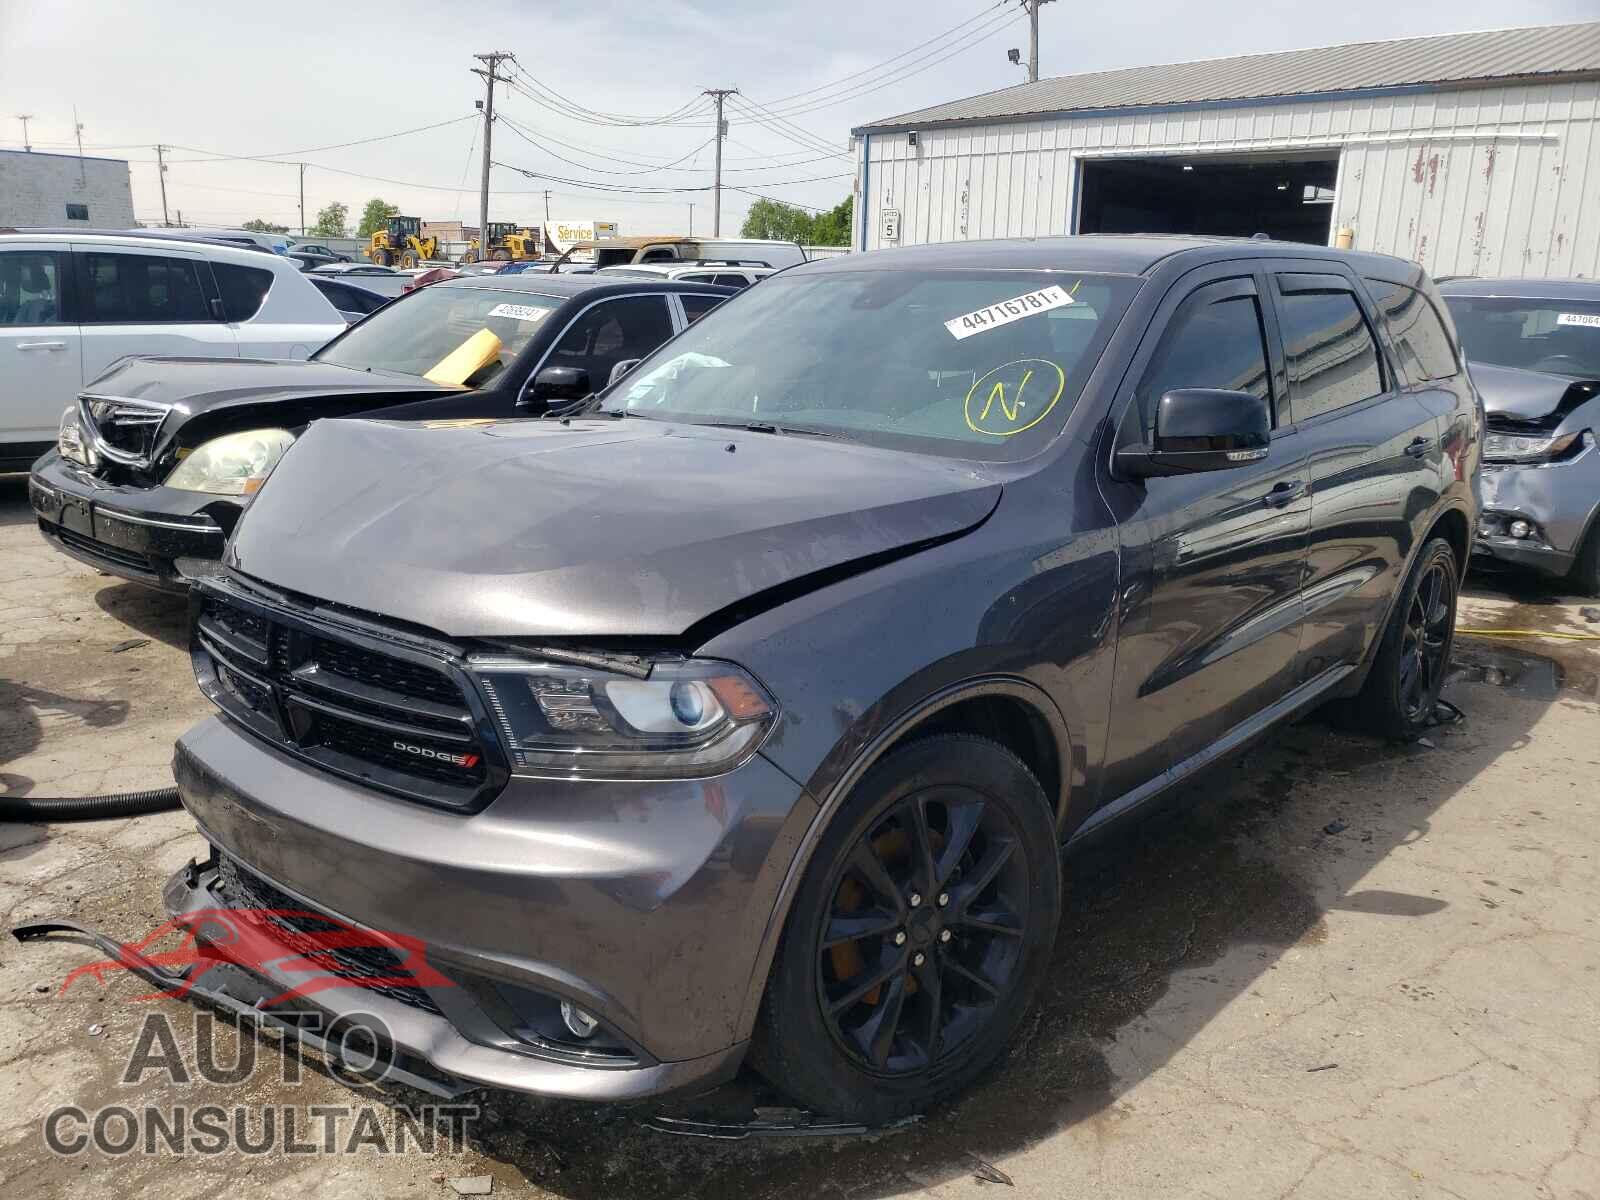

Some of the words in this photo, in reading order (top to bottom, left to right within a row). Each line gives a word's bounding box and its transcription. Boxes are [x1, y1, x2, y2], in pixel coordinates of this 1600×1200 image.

[558, 226, 592, 239] Service
[886, 224, 893, 237] 5
[961, 291, 1053, 329] 44716781
[393, 741, 466, 765] DODGE
